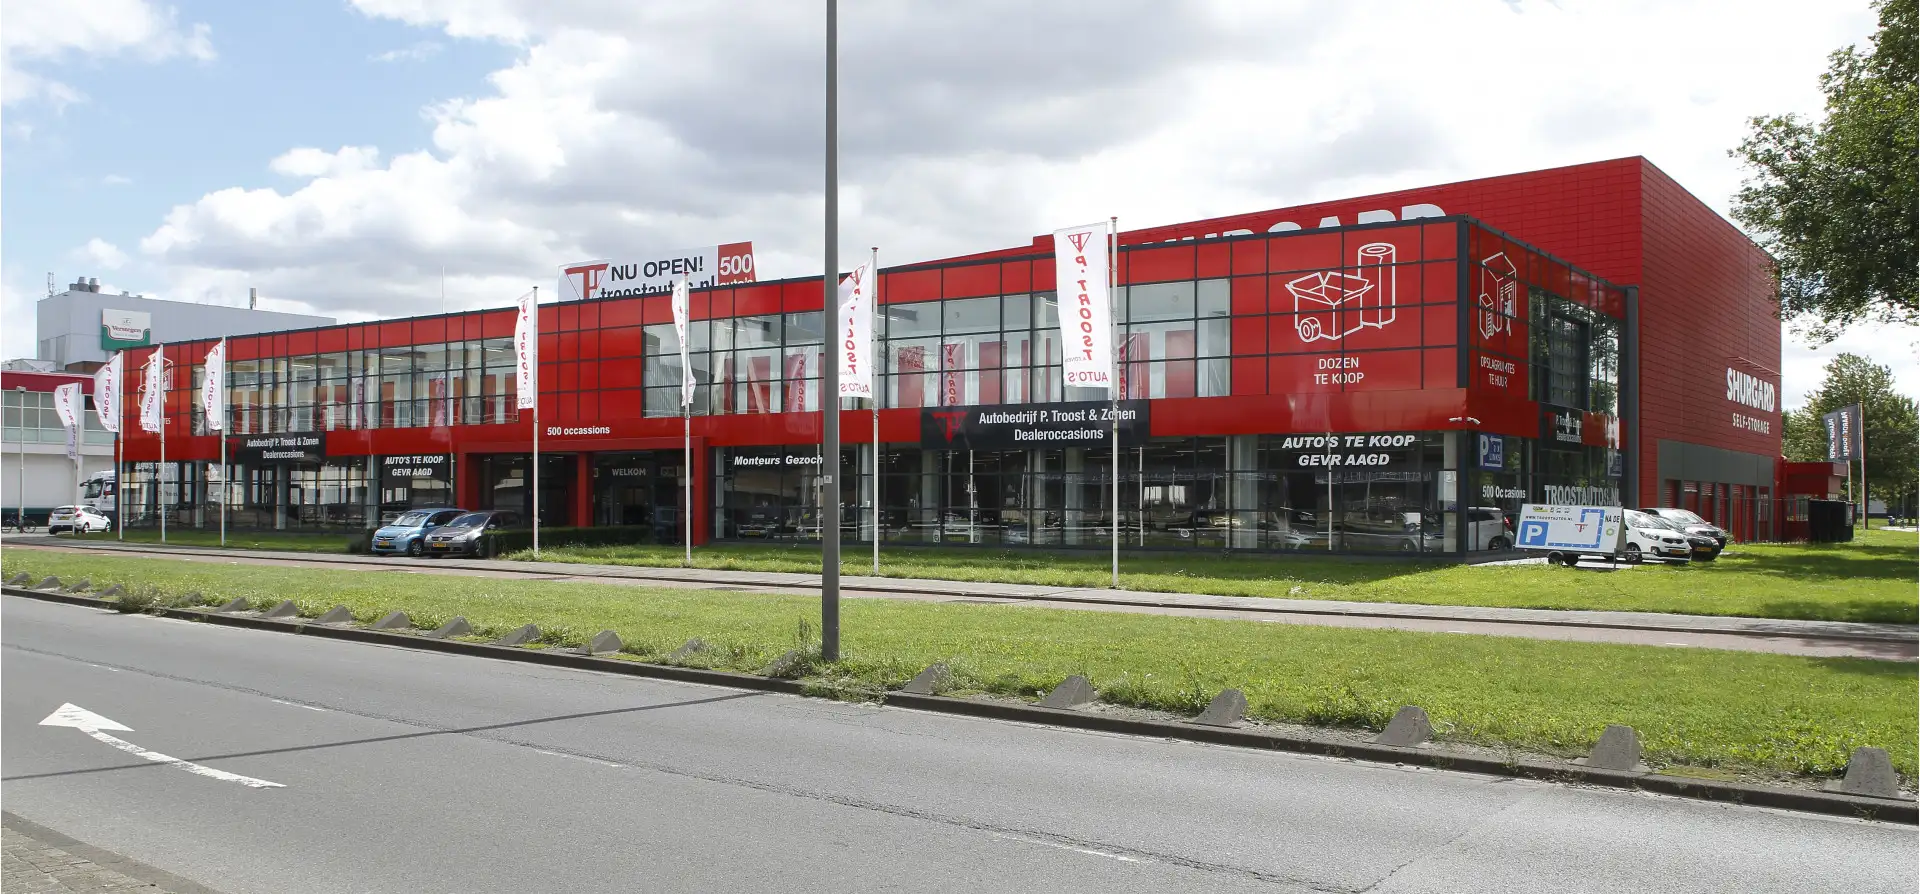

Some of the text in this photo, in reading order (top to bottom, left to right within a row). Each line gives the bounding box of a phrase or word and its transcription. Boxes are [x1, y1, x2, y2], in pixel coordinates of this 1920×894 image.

[611, 256, 703, 281] NU OPEN!
[720, 254, 752, 276] 500
[1319, 357, 1359, 370] DOZEN
[1314, 372, 1364, 384] TE KOOP
[1489, 373, 1495, 385] TE
[1727, 367, 1774, 413] SHURGARD
[979, 408, 1135, 425] Autobedrijf P. Troost & Zonen
[547, 425, 610, 436] 500 occassions
[1732, 413, 1769, 435] SELF-STORAGE
[1014, 427, 1104, 441] Dealeroccasions
[246, 439, 274, 449] Autobedrijf
[280, 437, 296, 446] Troost
[302, 437, 319, 446] Zonen
[1282, 435, 1415, 449] AUTO'S TE KOOP
[263, 450, 304, 459] Dealeroccasions
[1480, 434, 1489, 466] P
[385, 455, 444, 465] AUTO'S TE KOOP
[734, 454, 823, 466] Monteurs Gezoch
[1298, 454, 1390, 466] GEVR AAGD
[612, 468, 646, 476] WELKOM
[1482, 485, 1494, 498] 500
[1525, 524, 1543, 543] P
